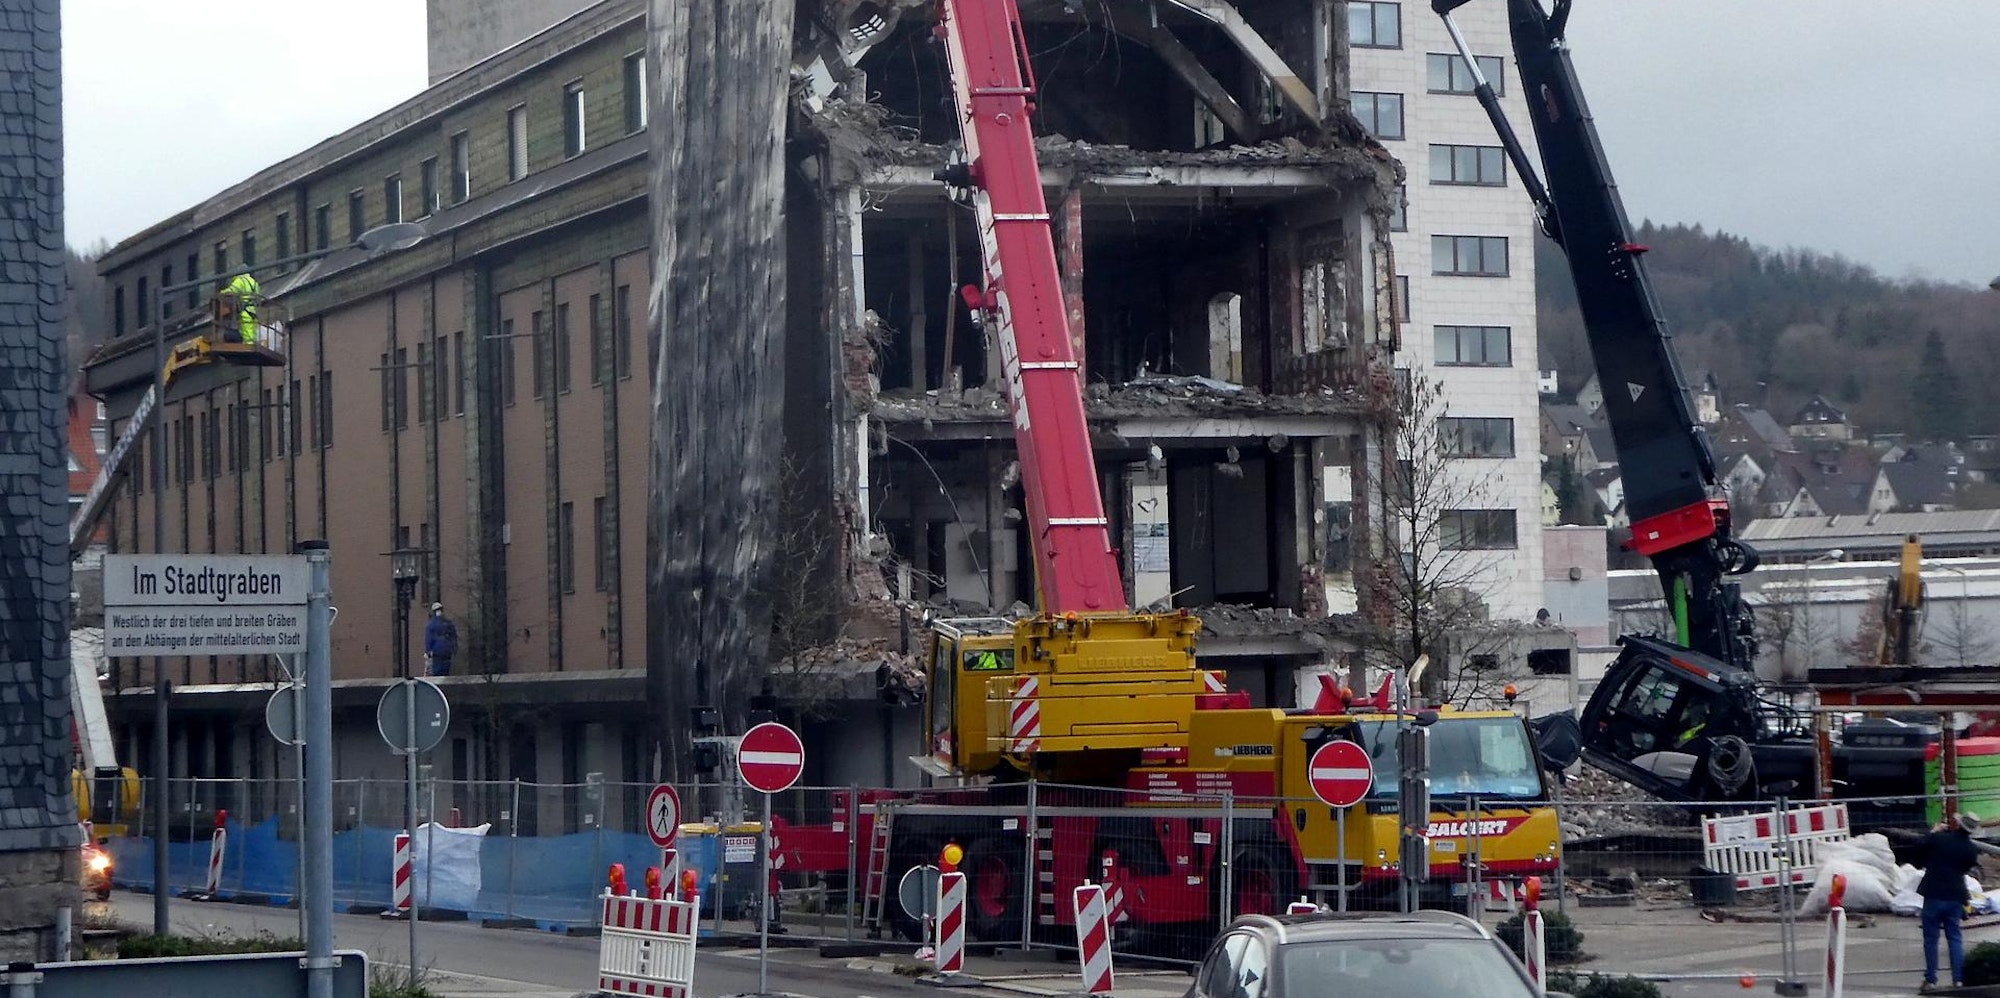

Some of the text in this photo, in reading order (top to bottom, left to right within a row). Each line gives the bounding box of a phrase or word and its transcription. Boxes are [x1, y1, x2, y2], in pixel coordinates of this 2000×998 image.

[133, 565, 282, 602] Im Stadtgraben
[112, 613, 297, 628] Westlich der drei tiefen und breiten Gräben
[112, 632, 301, 650] an den Abhängen der mittelalterlichen Stadt
[1233, 745, 1274, 756] LIEBHERR
